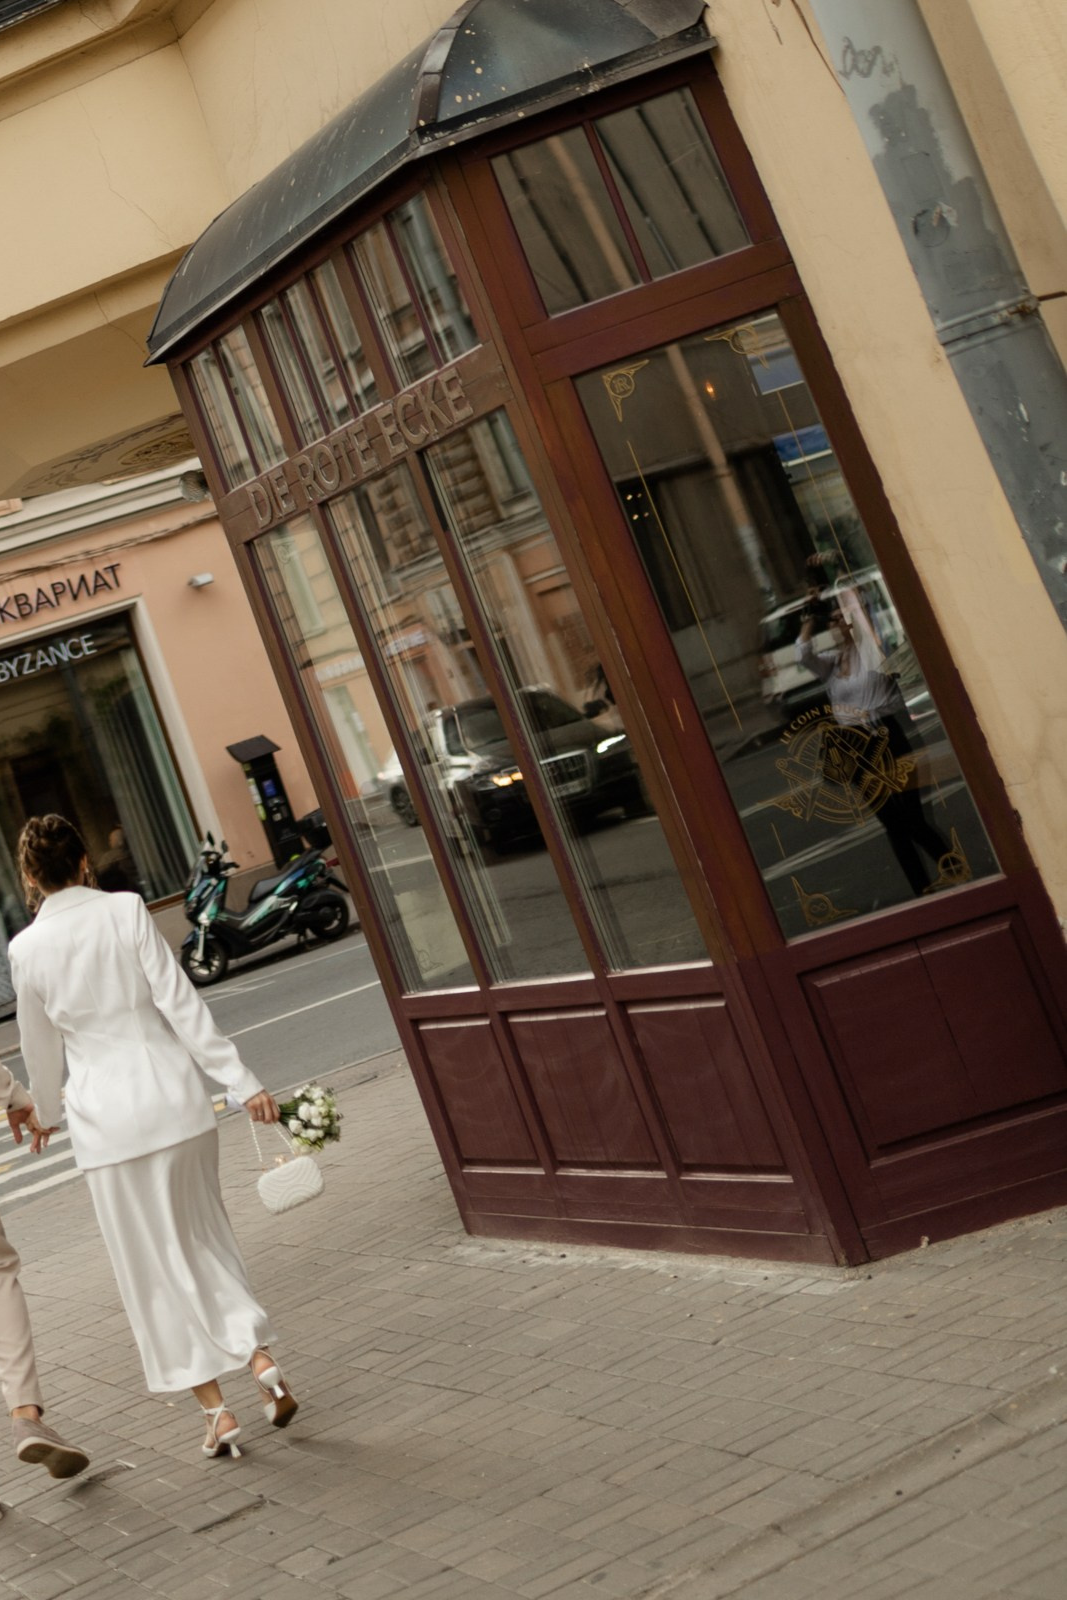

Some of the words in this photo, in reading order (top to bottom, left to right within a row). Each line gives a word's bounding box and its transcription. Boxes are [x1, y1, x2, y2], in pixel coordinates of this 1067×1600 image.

[246, 468, 297, 529] DIE
[290, 419, 382, 504] ROTE
[375, 367, 474, 459] ECKE
[790, 707, 821, 731] COIN
